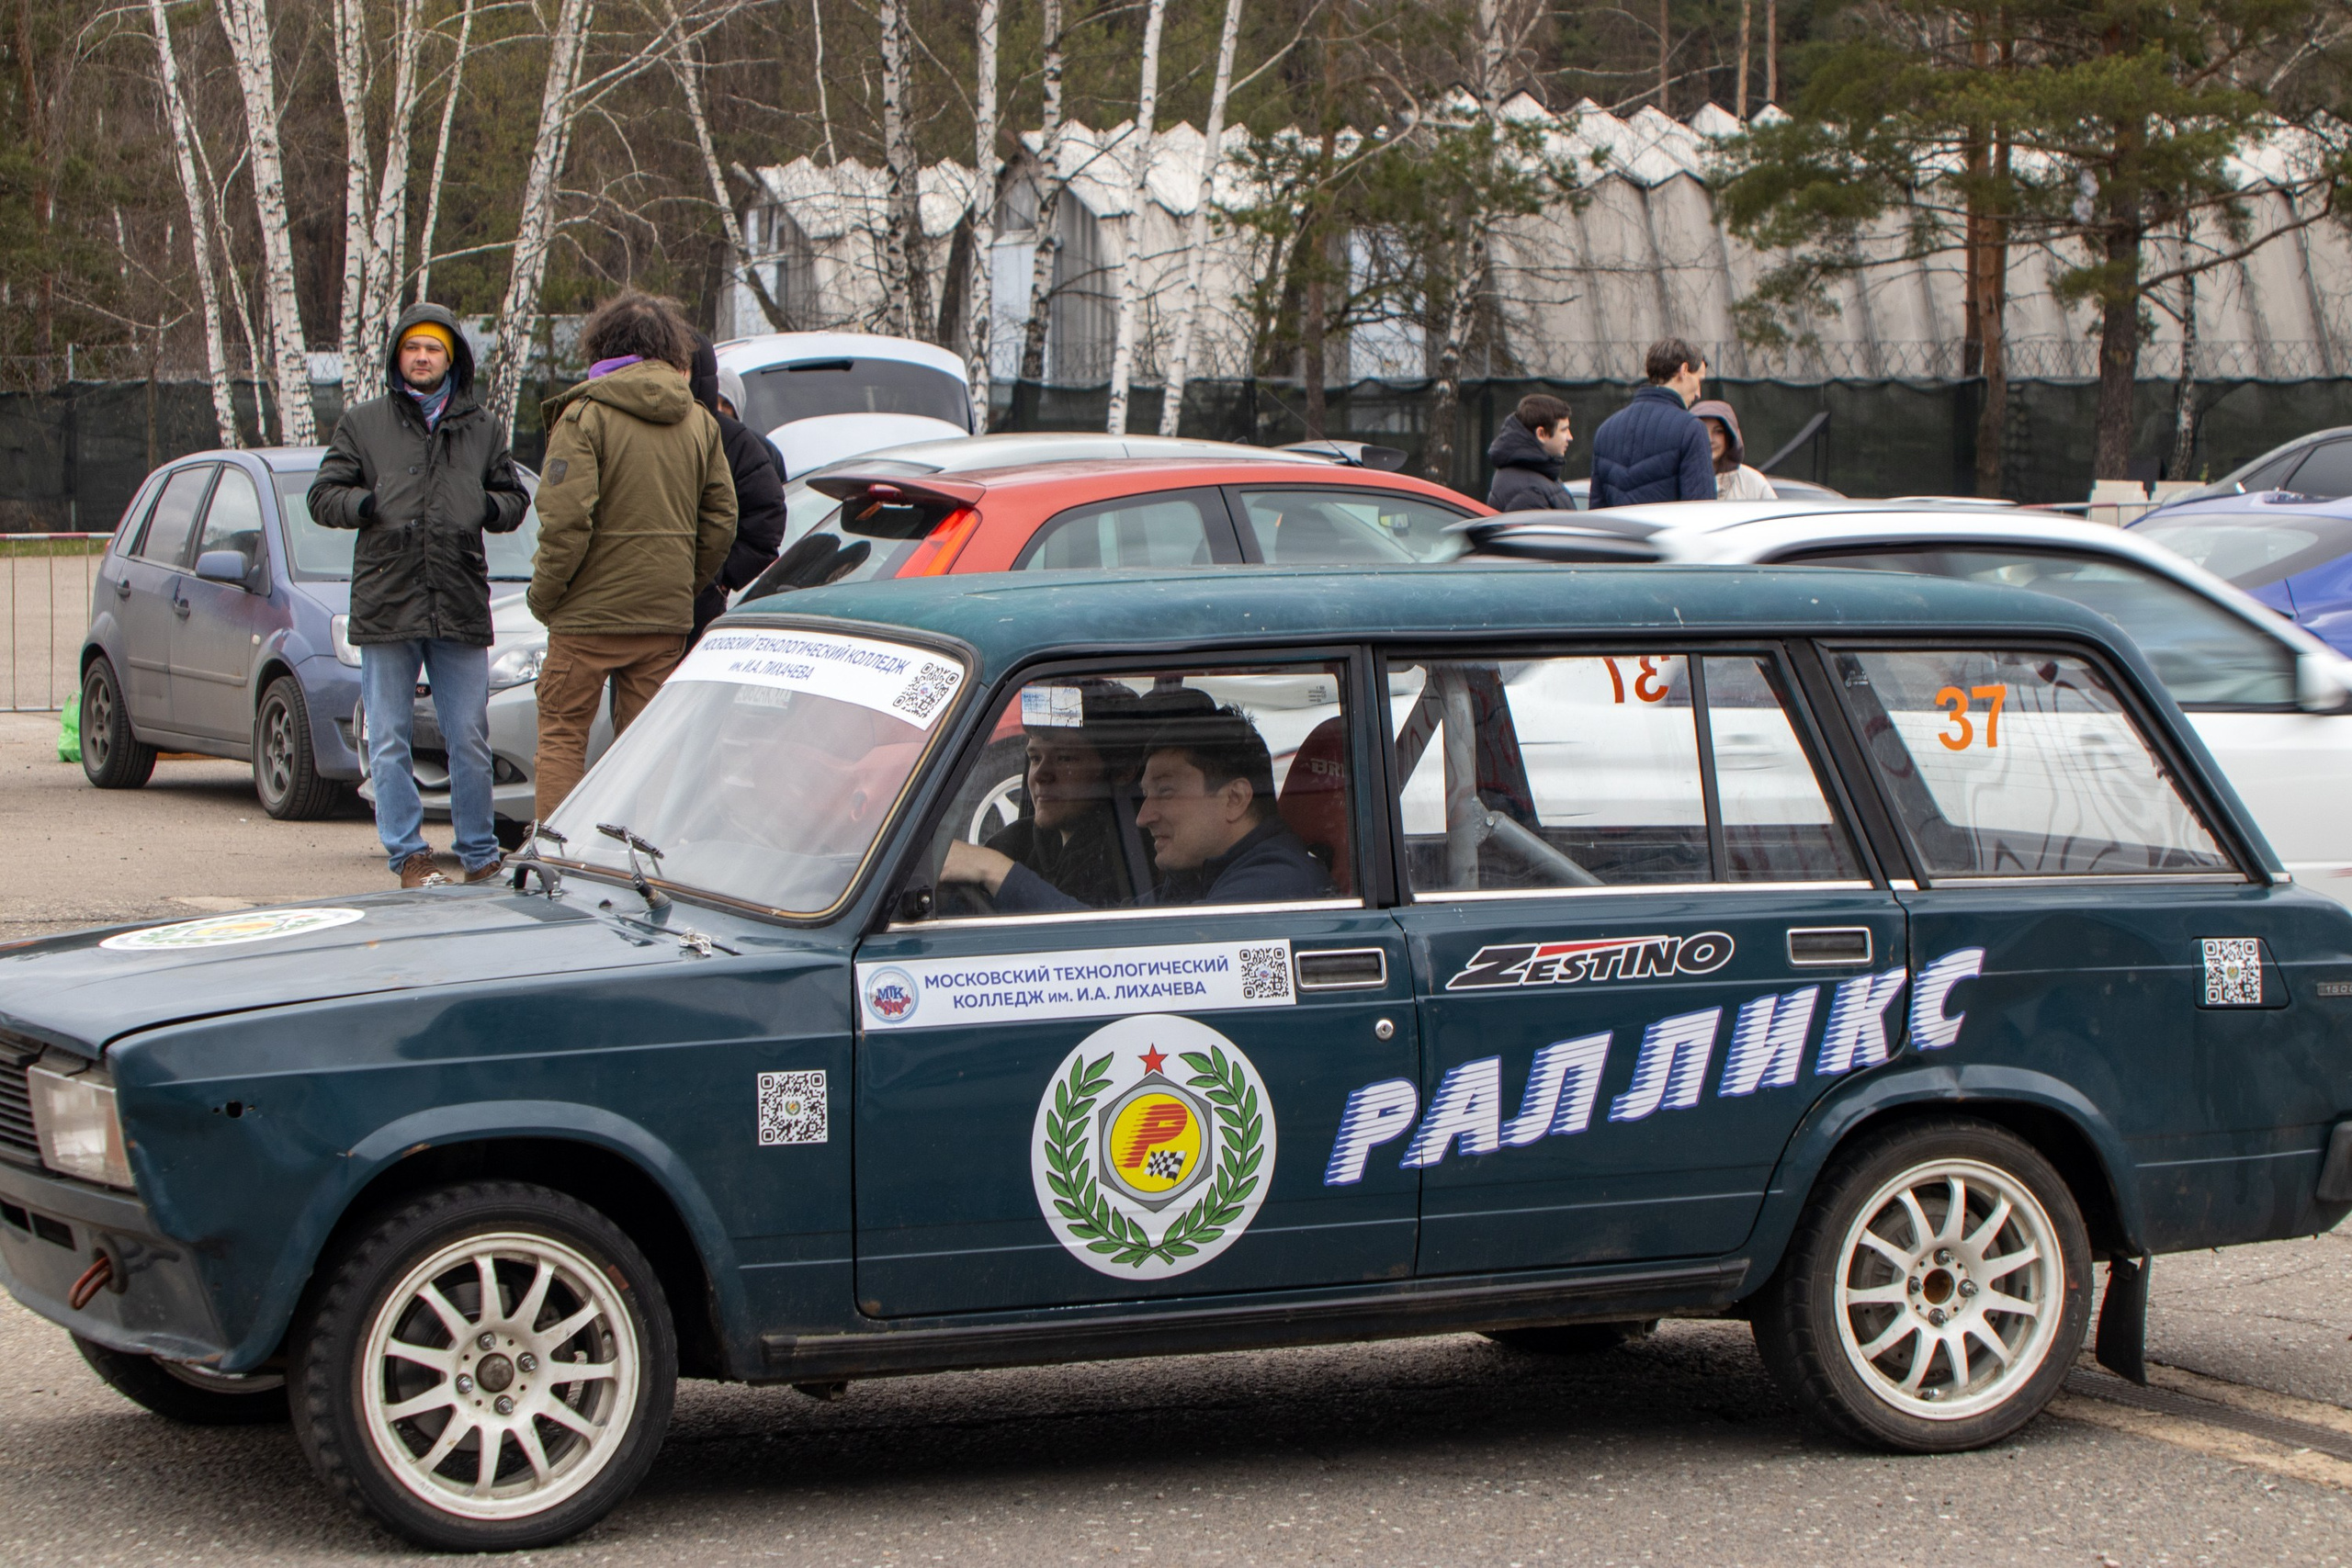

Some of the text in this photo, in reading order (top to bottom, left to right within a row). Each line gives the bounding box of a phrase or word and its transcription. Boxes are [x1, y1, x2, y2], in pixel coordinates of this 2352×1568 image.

[752, 637, 852, 661] ТЕХНОЛОГИЧЕСКИЙ
[843, 649, 911, 675] КОЛЛЕДЖ
[759, 660, 816, 681] ЛИХАЧЕВА
[1935, 684, 2007, 751] 37
[924, 954, 1229, 989] МОСКОВСКИЙ ТЕХНОЛОГИЧЕСКИЙ
[1445, 931, 1735, 990] ZESTINO
[876, 985, 905, 1000] МТК
[953, 980, 1207, 1010] КОЛЛЕДЖ им. И.А. ЛИХАЧЕВА
[1324, 947, 1985, 1186] РАЛЛИКС
